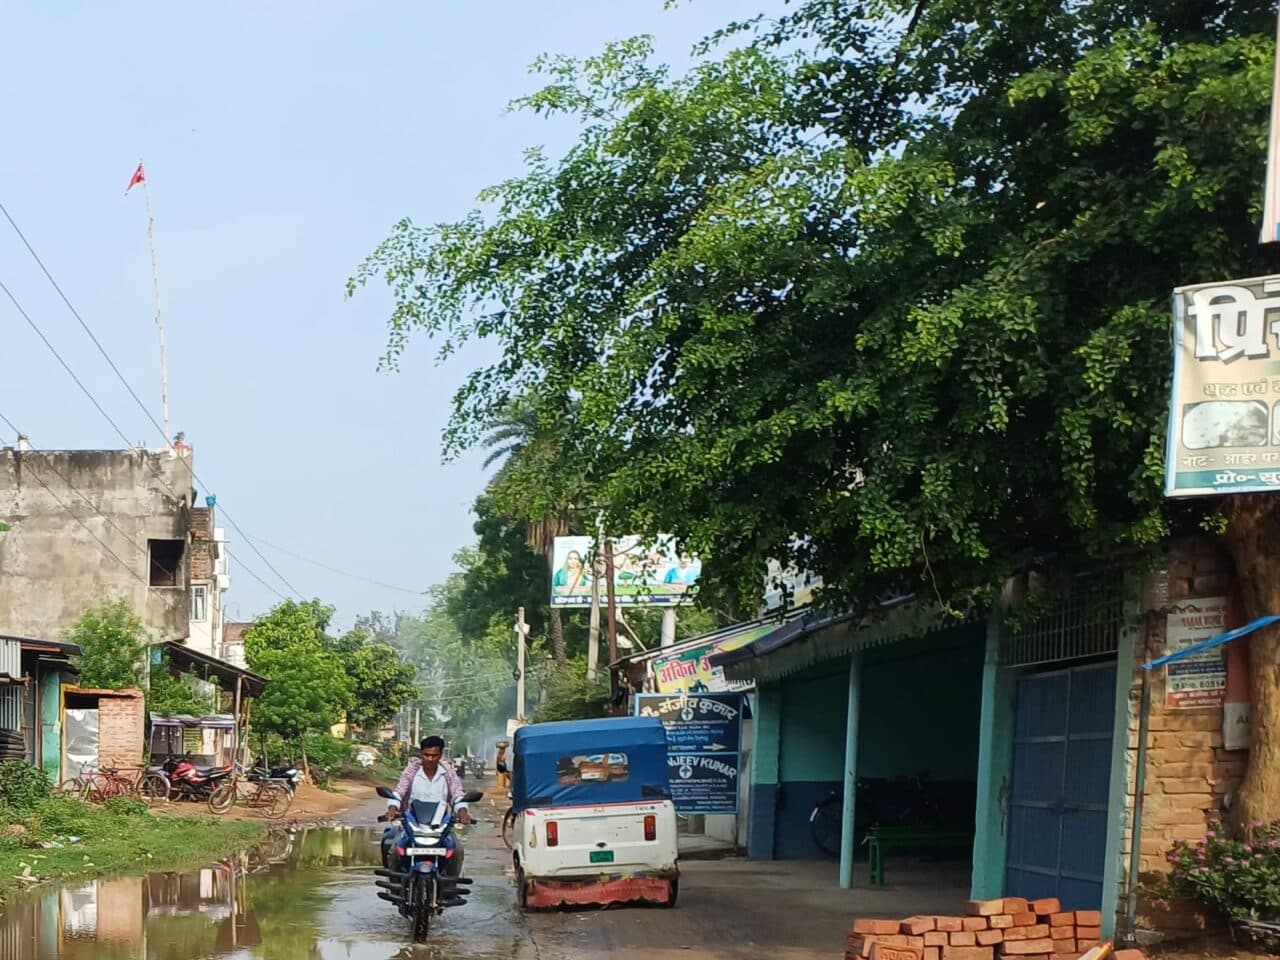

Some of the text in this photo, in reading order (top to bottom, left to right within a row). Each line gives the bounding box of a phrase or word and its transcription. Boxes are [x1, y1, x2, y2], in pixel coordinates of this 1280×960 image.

[659, 659, 697, 684] अंकित
[659, 694, 699, 713] संजीव
[699, 698, 738, 721] कुमार
[700, 758, 737, 779] KUMAR
